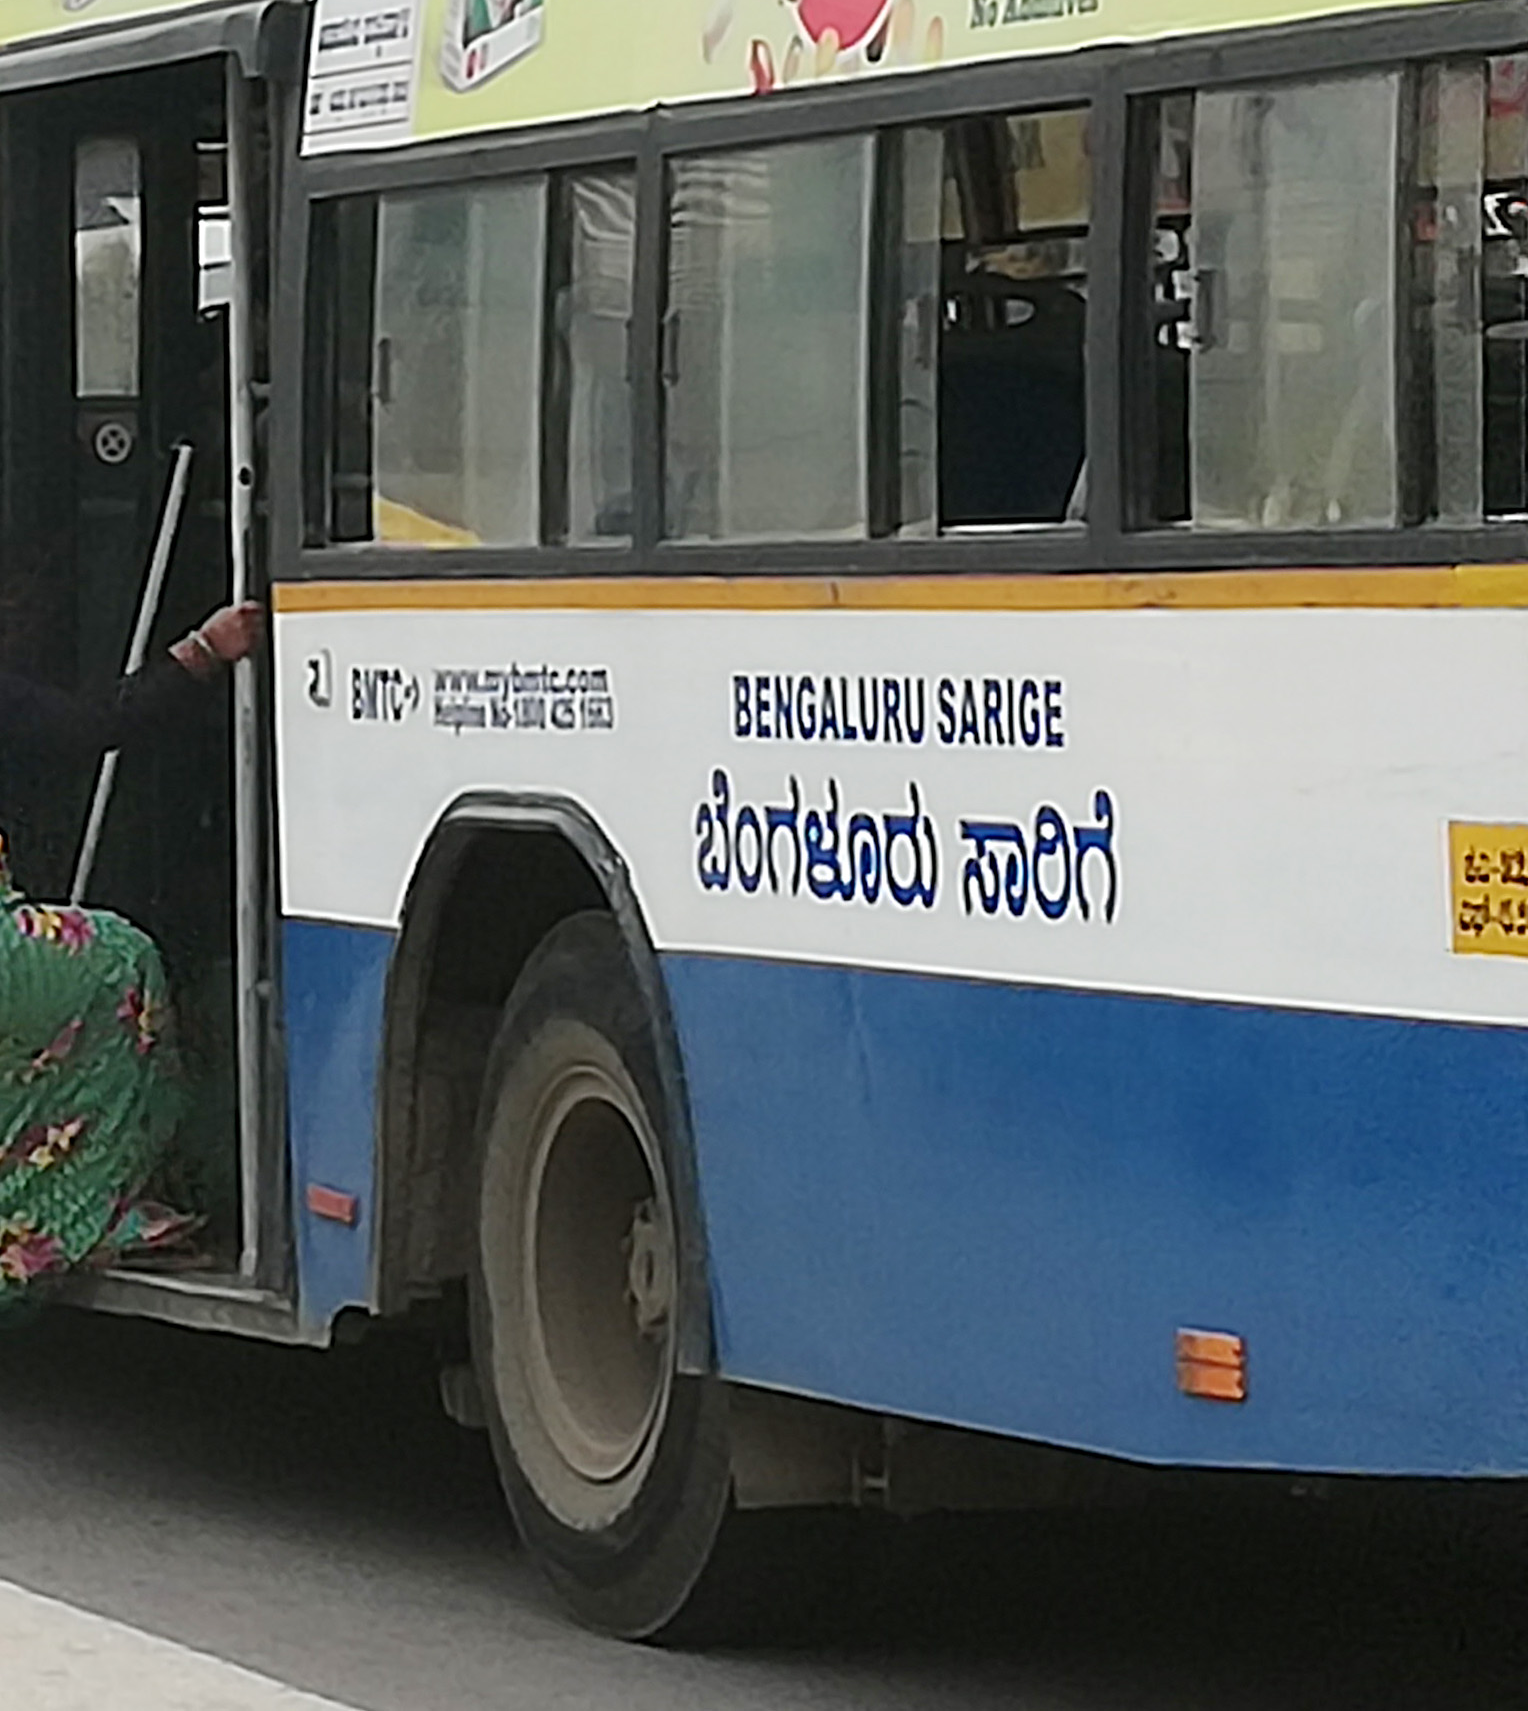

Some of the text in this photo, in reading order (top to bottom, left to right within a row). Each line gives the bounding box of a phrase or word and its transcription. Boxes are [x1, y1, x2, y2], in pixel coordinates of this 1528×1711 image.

[352, 667, 402, 721] BMTC
[732, 673, 1067, 750] BENGALURU SARIGE
[692, 767, 1121, 925] ಬೆಂಗಳೂರು ಸಾರಿಗೆ
